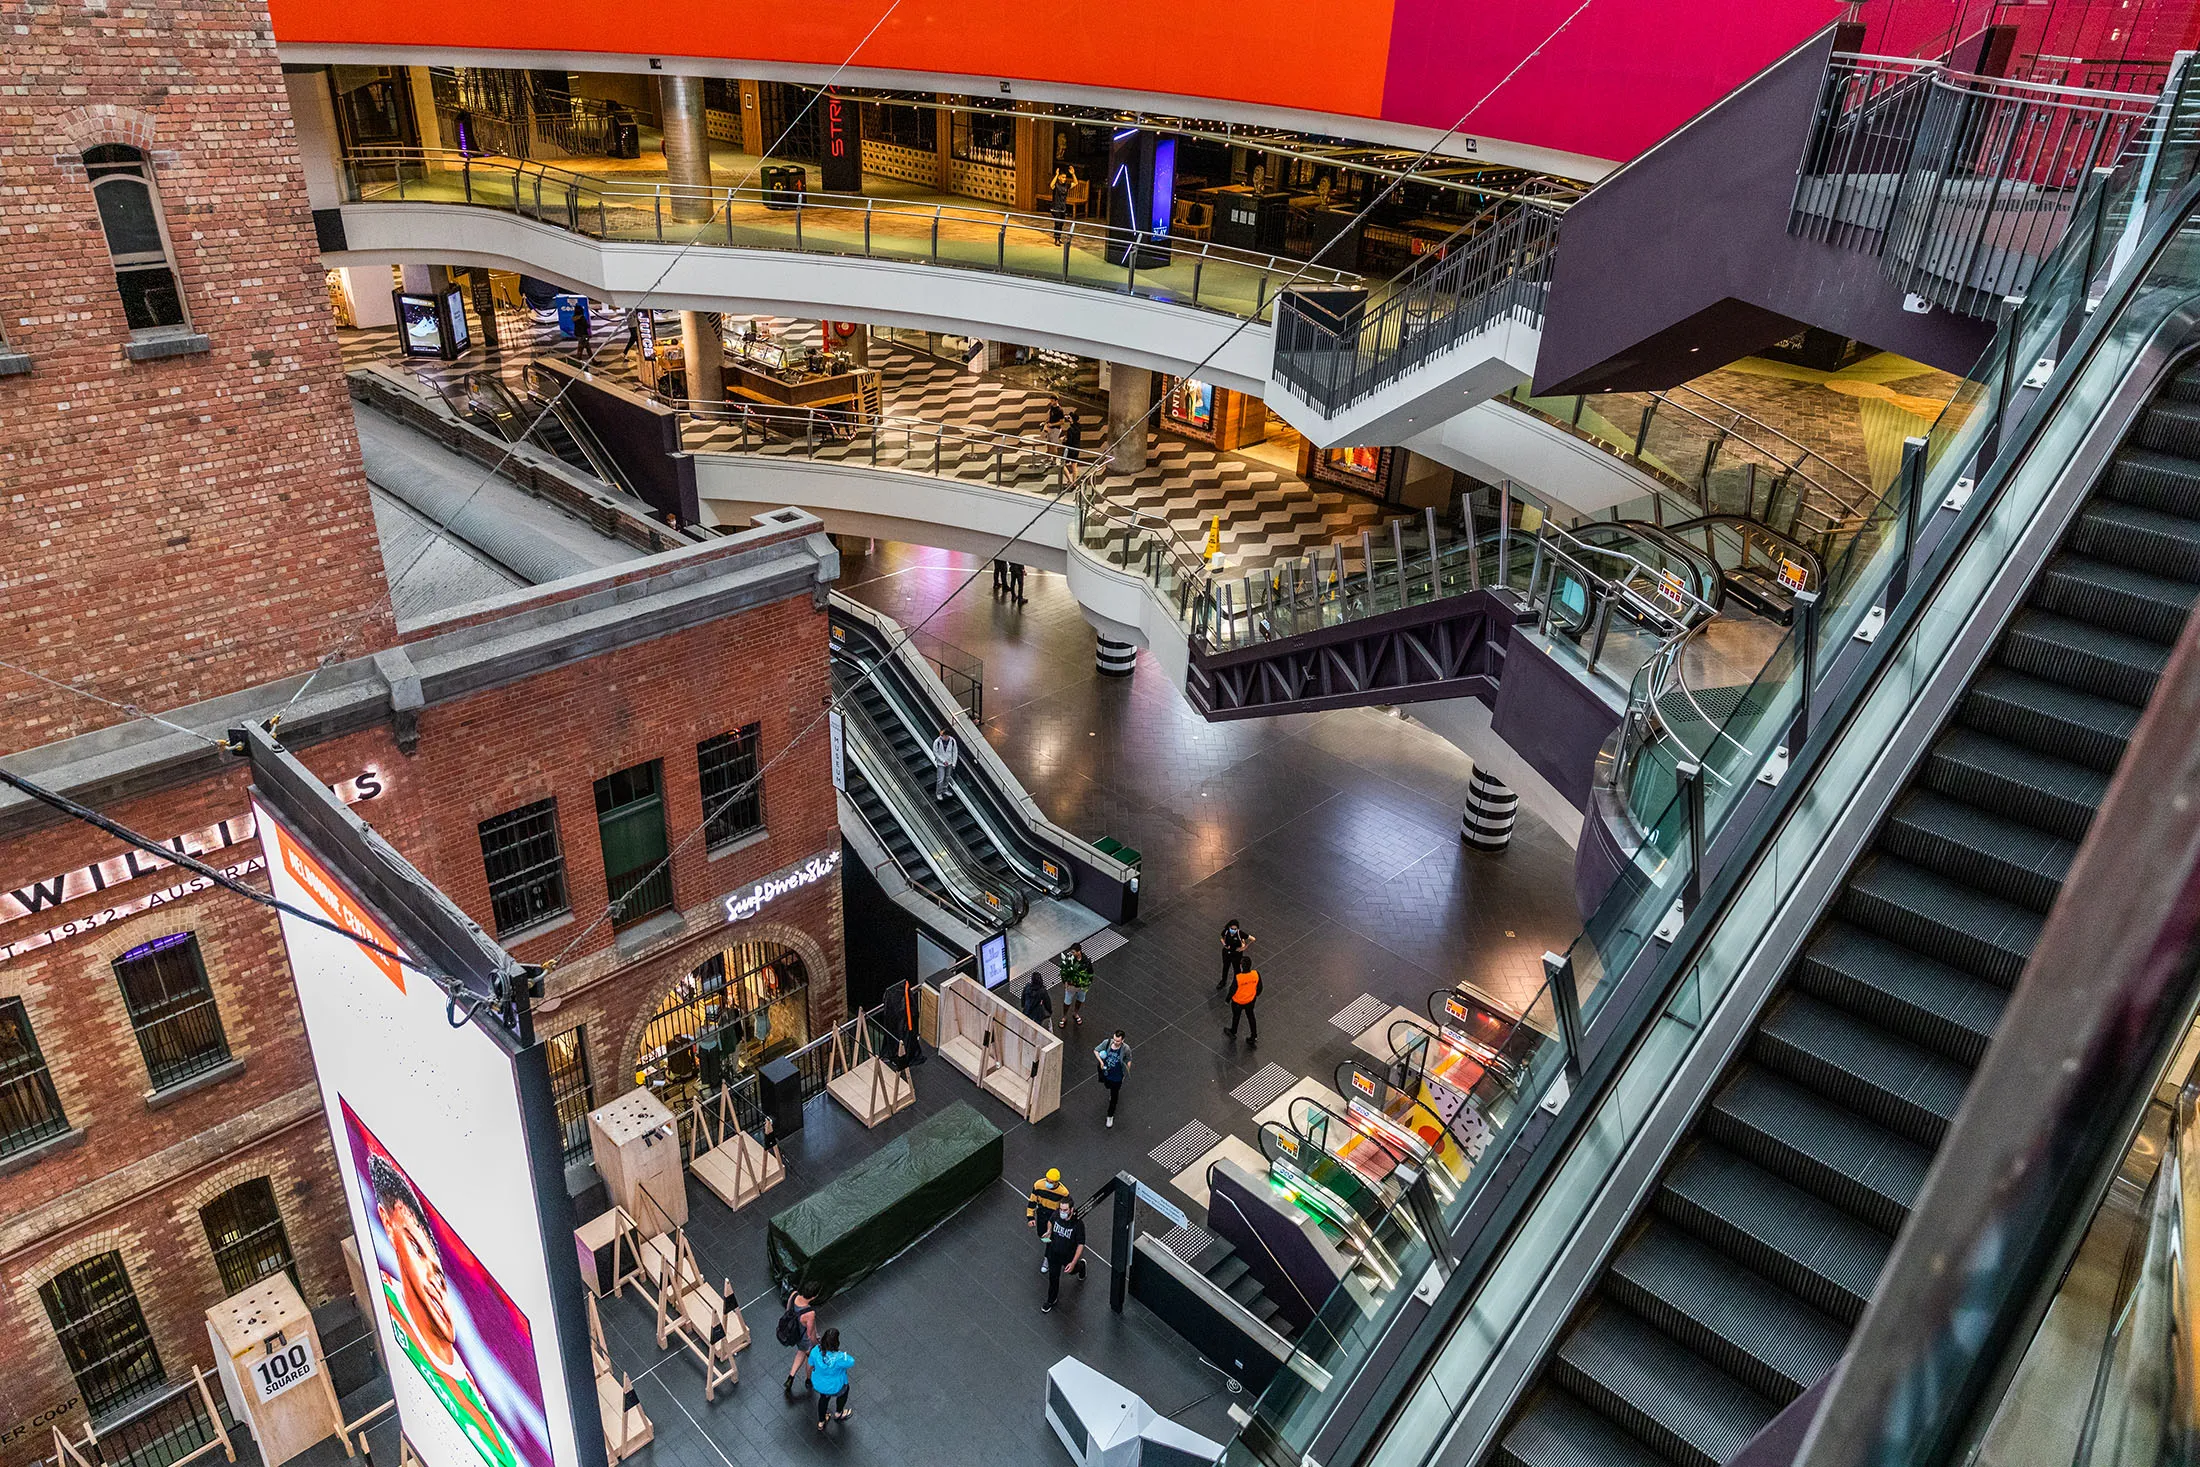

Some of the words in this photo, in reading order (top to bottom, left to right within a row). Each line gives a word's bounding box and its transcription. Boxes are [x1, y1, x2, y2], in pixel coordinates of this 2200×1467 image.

[257, 1344, 307, 1386] 100
[265, 1364, 311, 1395] SQUARED
[32, 1397, 78, 1427] COOP
